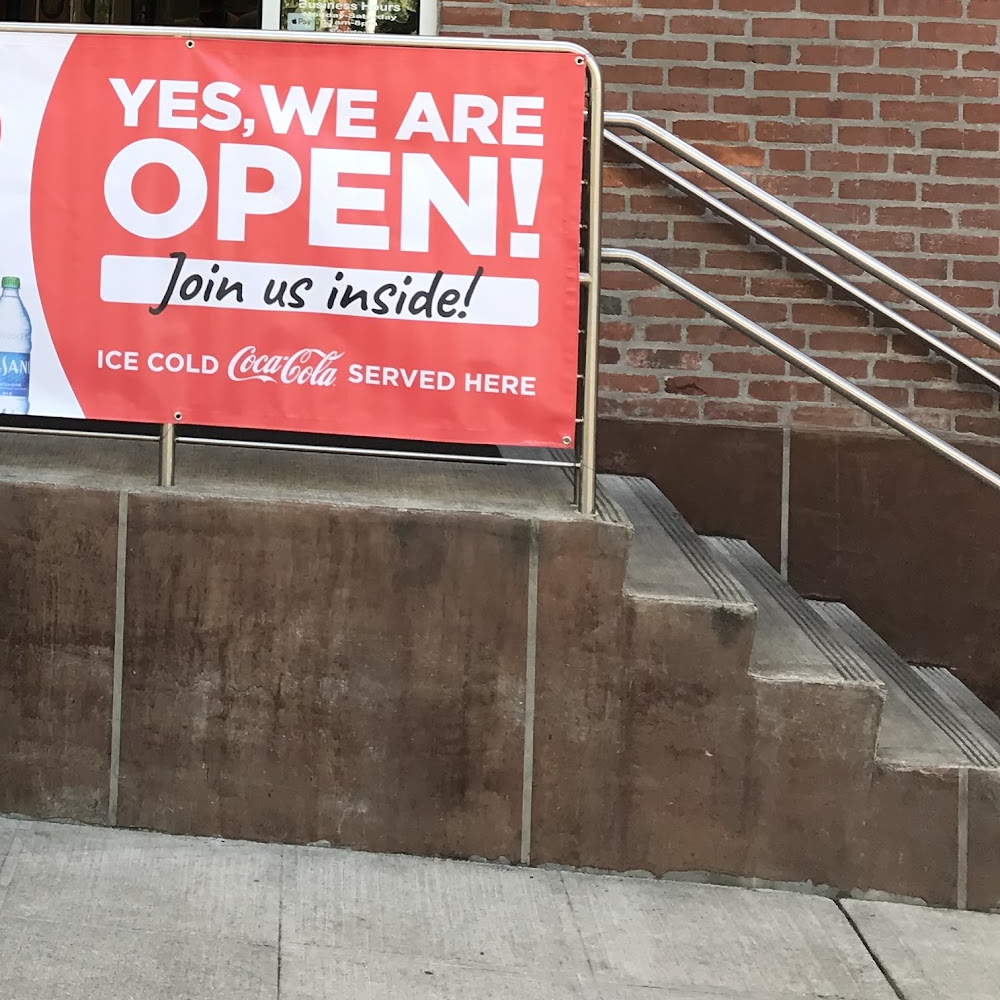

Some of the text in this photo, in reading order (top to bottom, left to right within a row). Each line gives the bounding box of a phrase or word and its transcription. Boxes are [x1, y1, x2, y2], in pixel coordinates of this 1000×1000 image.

[298, 0, 402, 13] Business Hours
[298, 17, 312, 26] Pay
[394, 91, 545, 147] ARE
[103, 137, 544, 259] OPEN!
[148, 252, 484, 319] Join us inside!
[97, 345, 537, 396] ICE COLD Coca-Cola SERVED HERE
